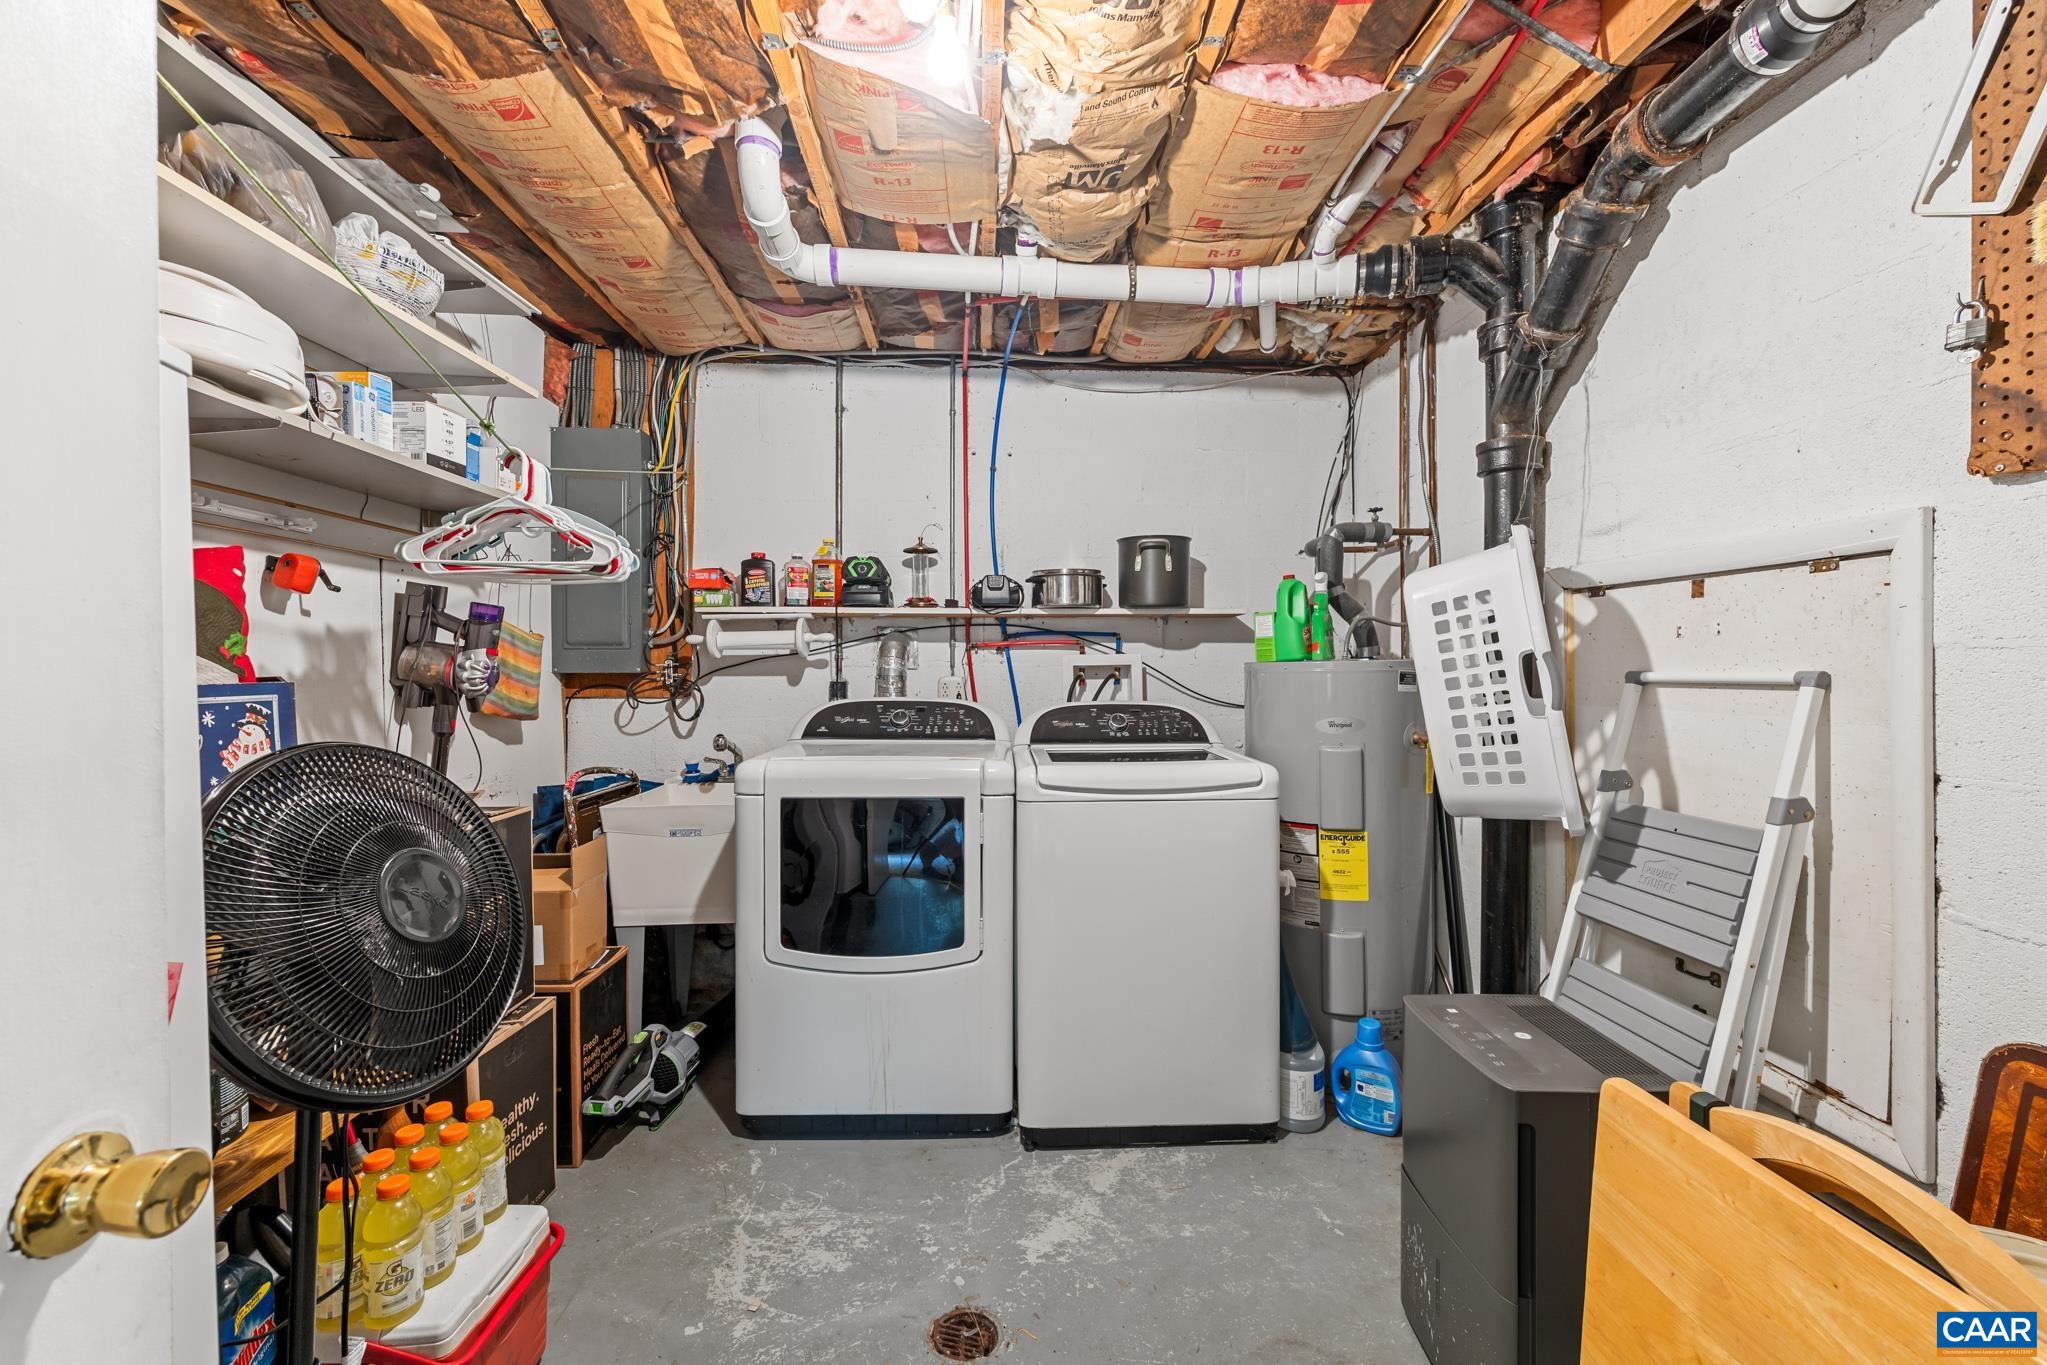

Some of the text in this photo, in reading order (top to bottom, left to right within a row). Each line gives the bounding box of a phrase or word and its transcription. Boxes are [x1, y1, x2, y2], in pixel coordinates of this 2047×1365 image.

[1116, 9, 1160, 22] Manville
[1084, 102, 1101, 112] and
[1102, 93, 1127, 108] Sound
[1128, 82, 1158, 99] Control
[1262, 145, 1307, 155] R-13
[873, 177, 912, 187] R-13
[1207, 249, 1242, 258] R-13
[1327, 720, 1353, 729] Whirlpool
[583, 1034, 599, 1055] Fresh
[583, 1031, 626, 1080] Meals Delivered
[584, 1082, 591, 1093] to
[501, 1091, 539, 1130] ealthy.
[504, 1120, 528, 1148] esh.
[505, 1121, 548, 1167] elicious.
[375, 1268, 415, 1294] ZERO
